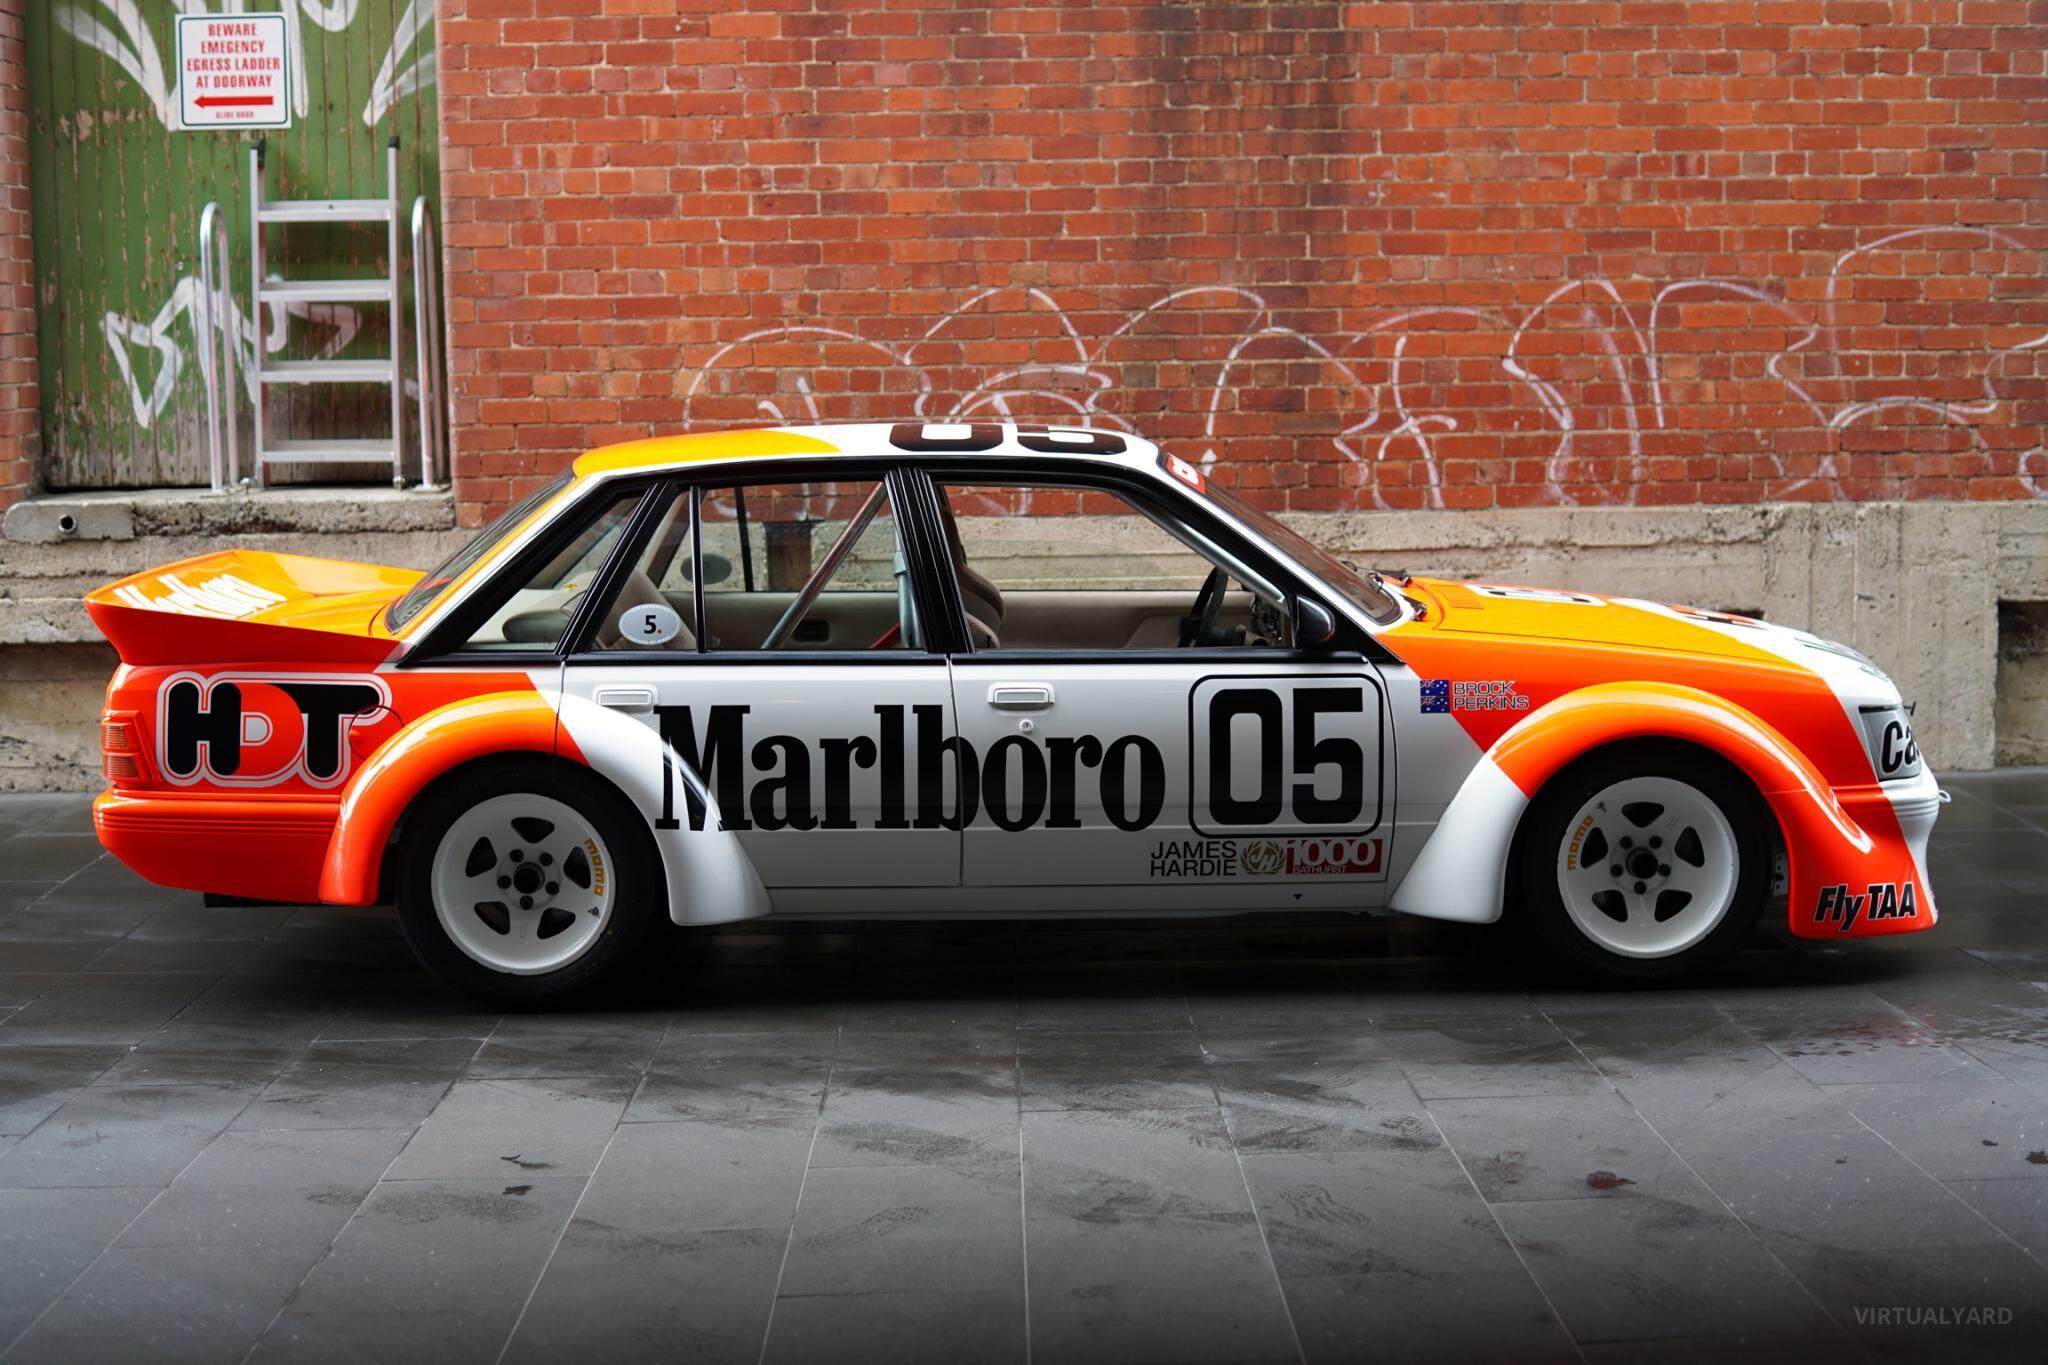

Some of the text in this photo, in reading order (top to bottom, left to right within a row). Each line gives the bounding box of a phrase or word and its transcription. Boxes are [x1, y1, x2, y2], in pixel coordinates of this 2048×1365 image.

[208, 23, 257, 36] BEWARE
[201, 40, 265, 53] EMEGENCY
[187, 58, 280, 71] EGRESS LADDER
[195, 75, 272, 88] AT DOORWAY
[1453, 680, 1516, 696] BROCK
[1453, 695, 1529, 710] PERKINS
[160, 676, 388, 784] HDT
[1881, 719, 1920, 774] Ca
[1209, 687, 1363, 825] 05
[654, 704, 1166, 832] Marlboro
[1151, 841, 1237, 859] JAMES
[1287, 839, 1376, 865] 1000
[1151, 859, 1237, 876] HARDIE
[1292, 865, 1348, 874] BATHURST
[1814, 882, 1917, 932] Fly TAA
